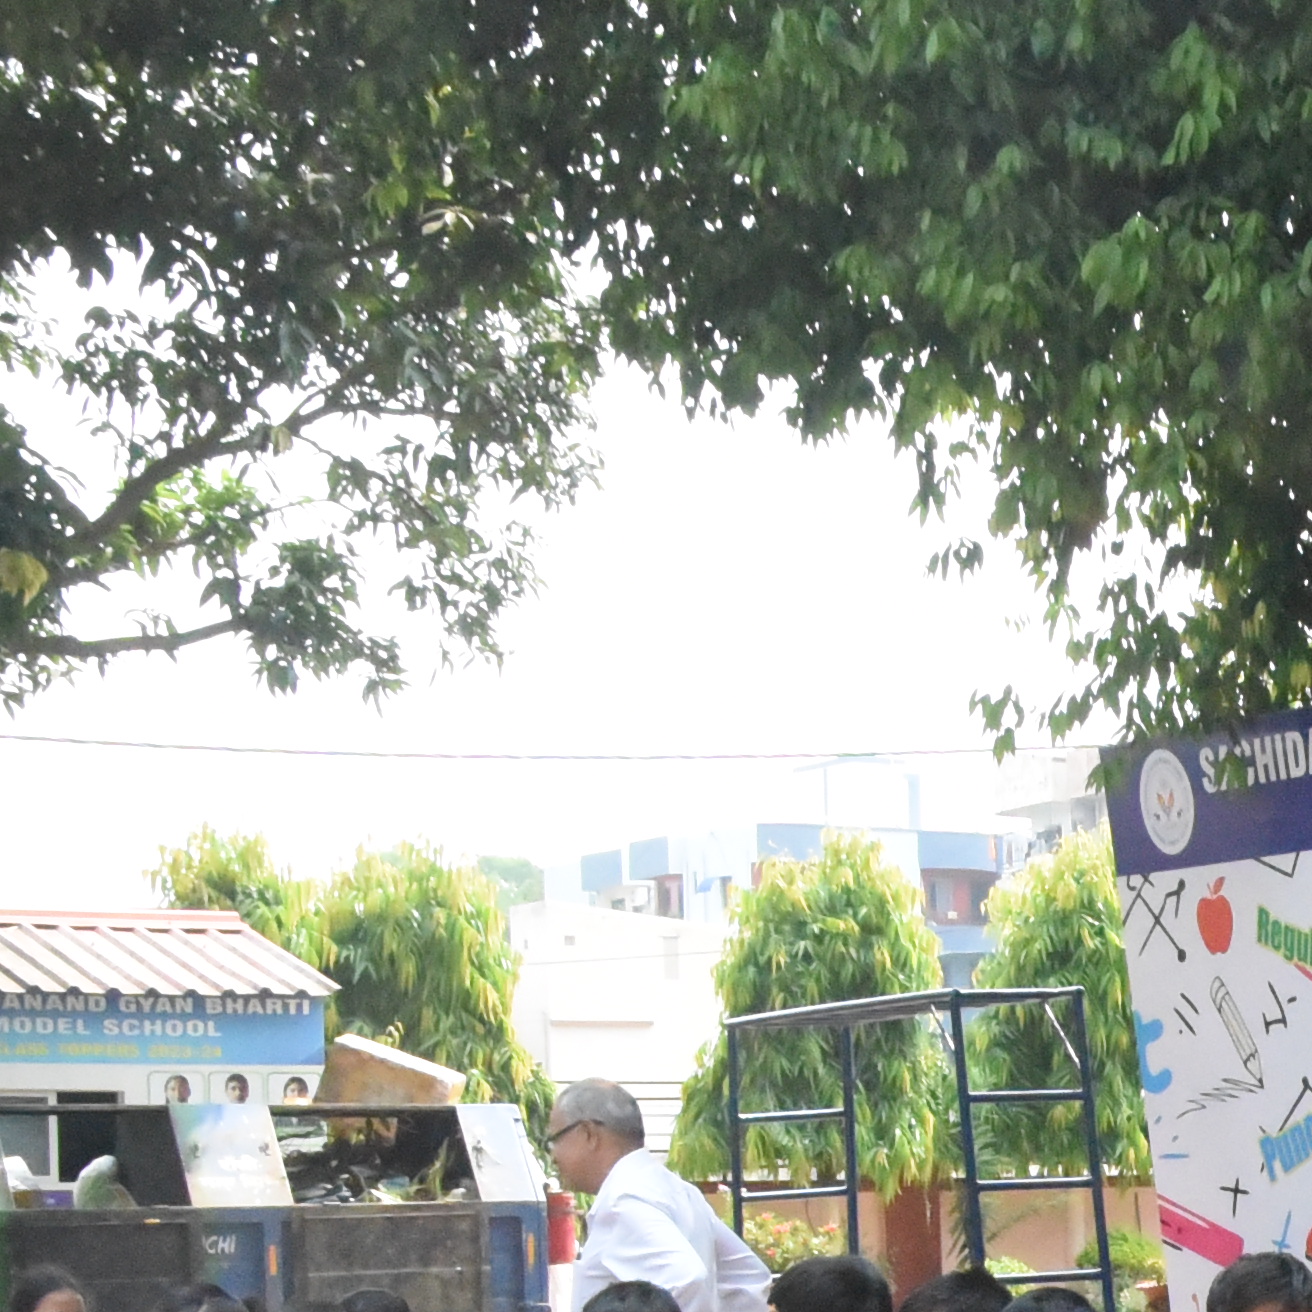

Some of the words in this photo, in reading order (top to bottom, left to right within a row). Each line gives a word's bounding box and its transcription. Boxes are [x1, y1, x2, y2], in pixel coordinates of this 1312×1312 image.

[118, 996, 193, 1013] GYAN
[205, 997, 311, 1015] BHARTI
[103, 1018, 222, 1036] SCHOOL
